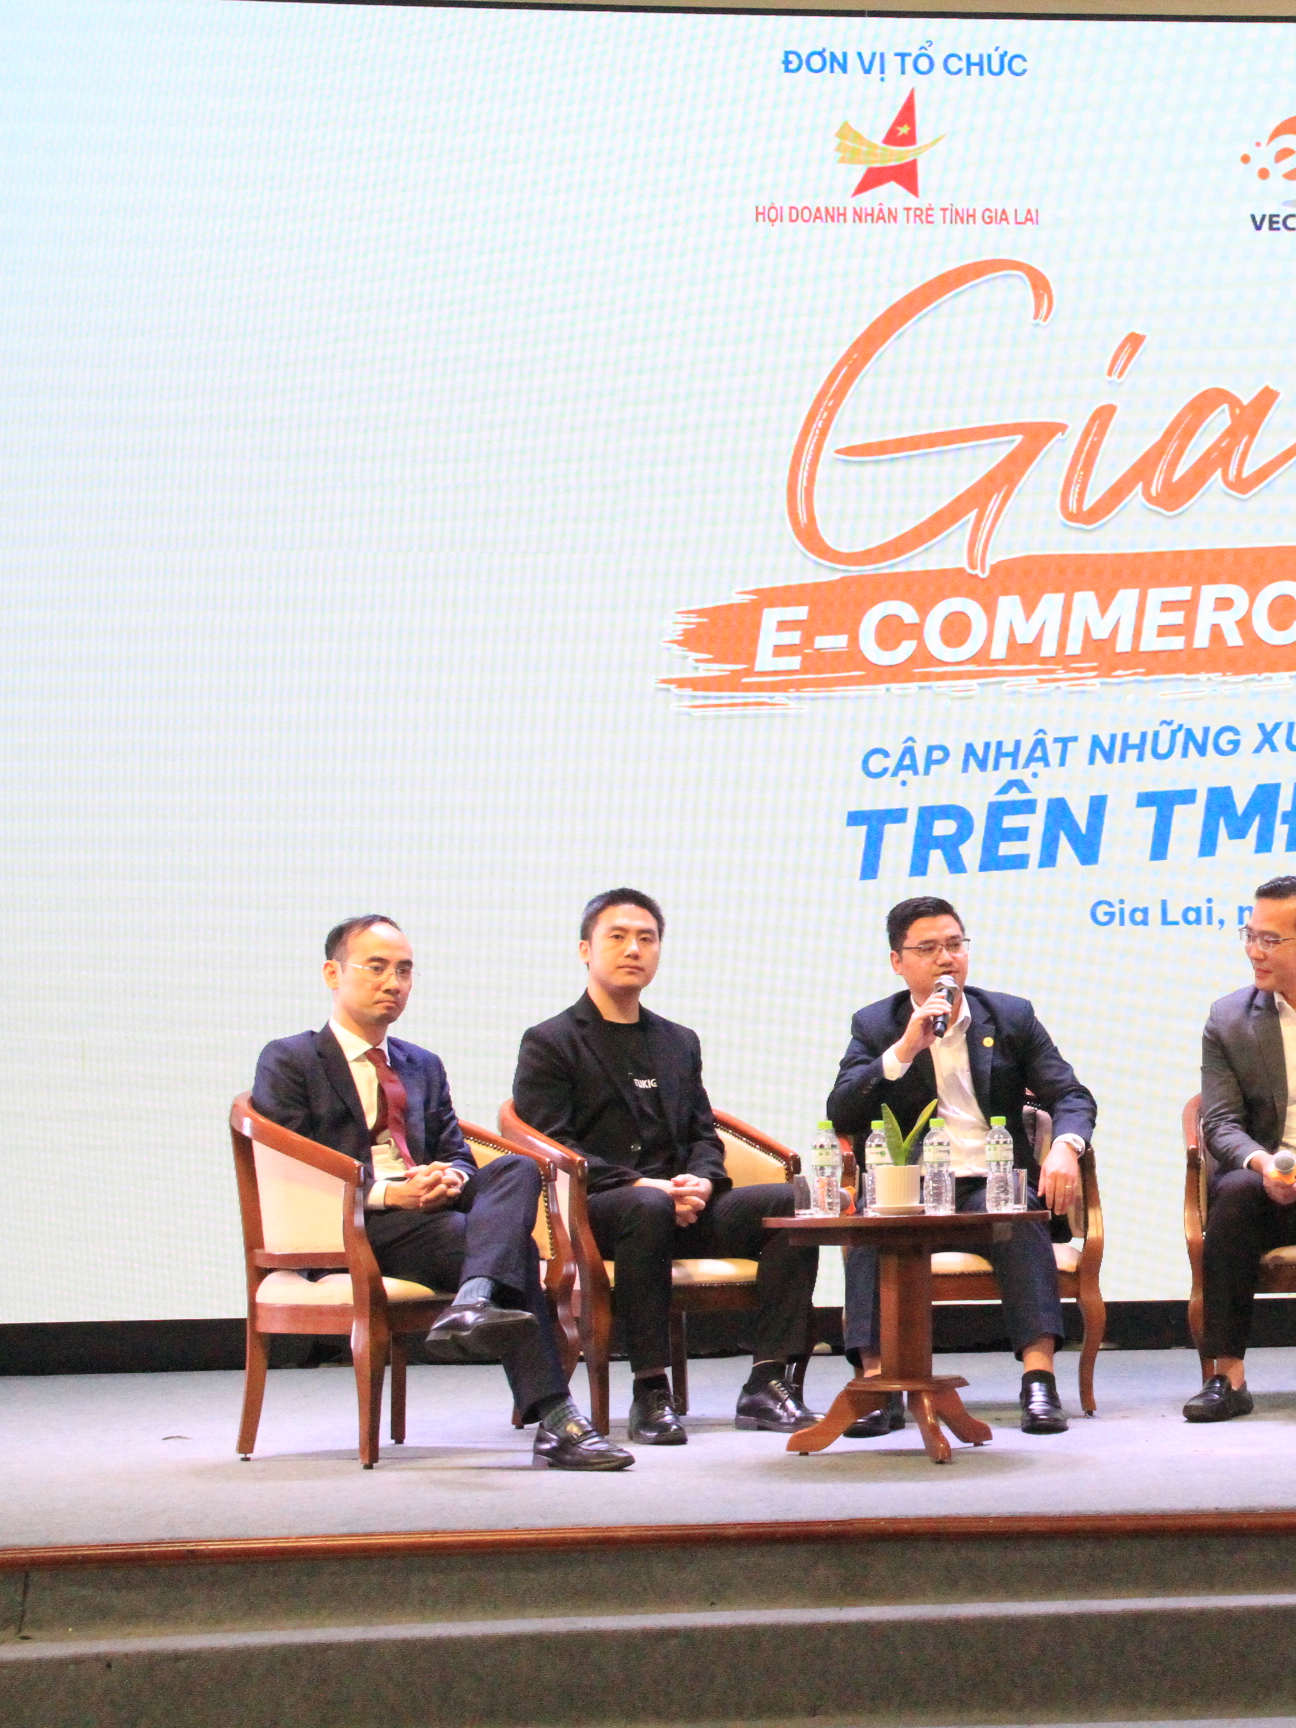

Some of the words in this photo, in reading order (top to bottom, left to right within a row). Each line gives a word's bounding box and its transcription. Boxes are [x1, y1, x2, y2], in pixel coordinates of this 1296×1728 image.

[780, 47, 849, 75] ĐƠN
[855, 50, 887, 83] VỊ
[893, 39, 936, 76] TỔ
[942, 45, 1028, 77] CHỨC
[755, 203, 784, 227] HỘI
[788, 205, 848, 224] DOANH
[851, 202, 898, 225] NHÂN
[981, 207, 1011, 226] GIA
[1014, 207, 1039, 226] LAI
[860, 735, 951, 787] CẬP
[961, 728, 1079, 779] NHẬT
[1087, 719, 1242, 766] NHỮNG
[845, 778, 1109, 881] TRÊN
[1089, 898, 1150, 927] Gia
[1160, 897, 1226, 930] Lai,
